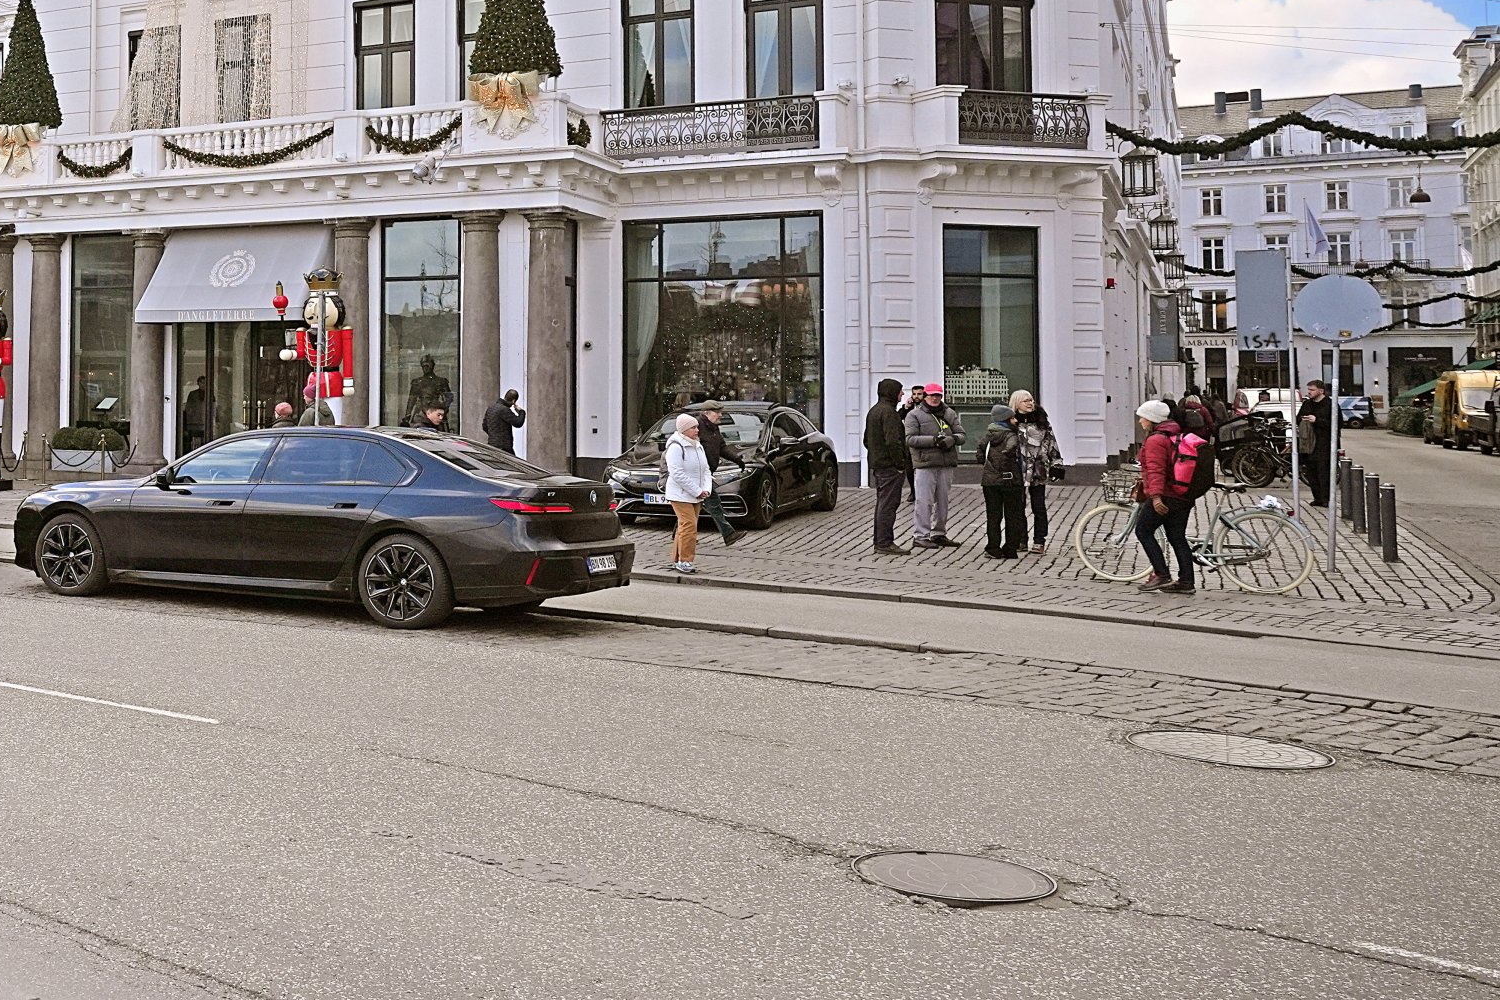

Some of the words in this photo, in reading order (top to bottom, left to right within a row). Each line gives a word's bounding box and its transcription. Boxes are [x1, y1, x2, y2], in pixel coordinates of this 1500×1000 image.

[177, 309, 255, 321] D'ANGLETERRE
[1244, 332, 1280, 349] ISA
[649, 495, 659, 503] BL
